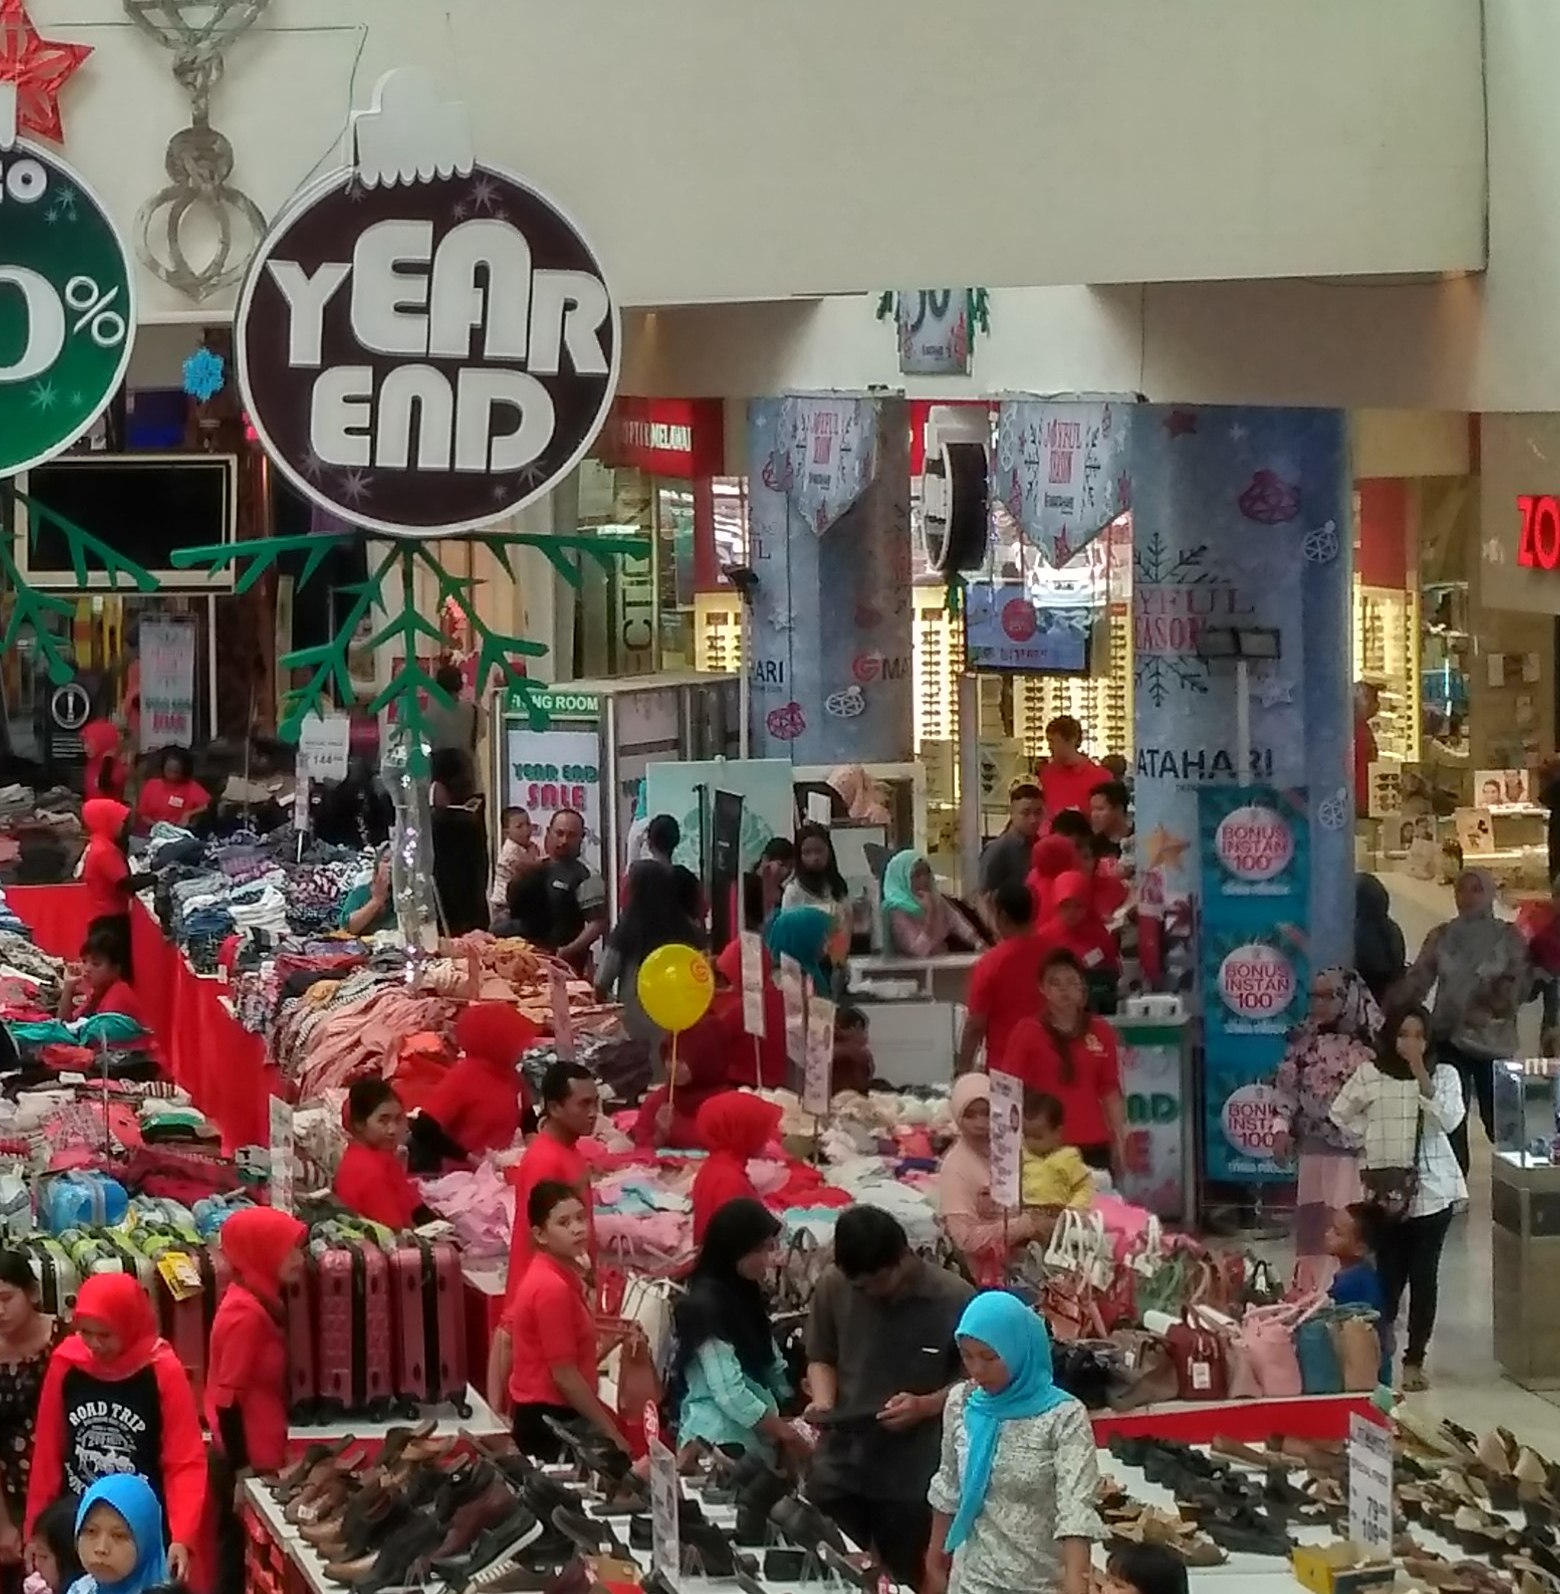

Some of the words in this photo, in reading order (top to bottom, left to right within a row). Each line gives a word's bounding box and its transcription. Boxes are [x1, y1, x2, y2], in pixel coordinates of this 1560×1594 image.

[267, 218, 611, 376] YEAR
[311, 364, 555, 474] END
[555, 696, 599, 711] ROOM
[512, 763, 559, 782] YEAR
[562, 764, 600, 783] END
[526, 783, 586, 812] SALE
[1222, 826, 1289, 840] BONUS
[1222, 840, 1288, 854] INSTAN
[1225, 964, 1290, 979] BONUS
[1225, 979, 1290, 992] INSTAN
[1239, 992, 1273, 1009] 100
[68, 1401, 108, 1427] ROAD
[111, 1402, 146, 1433] TRIP
